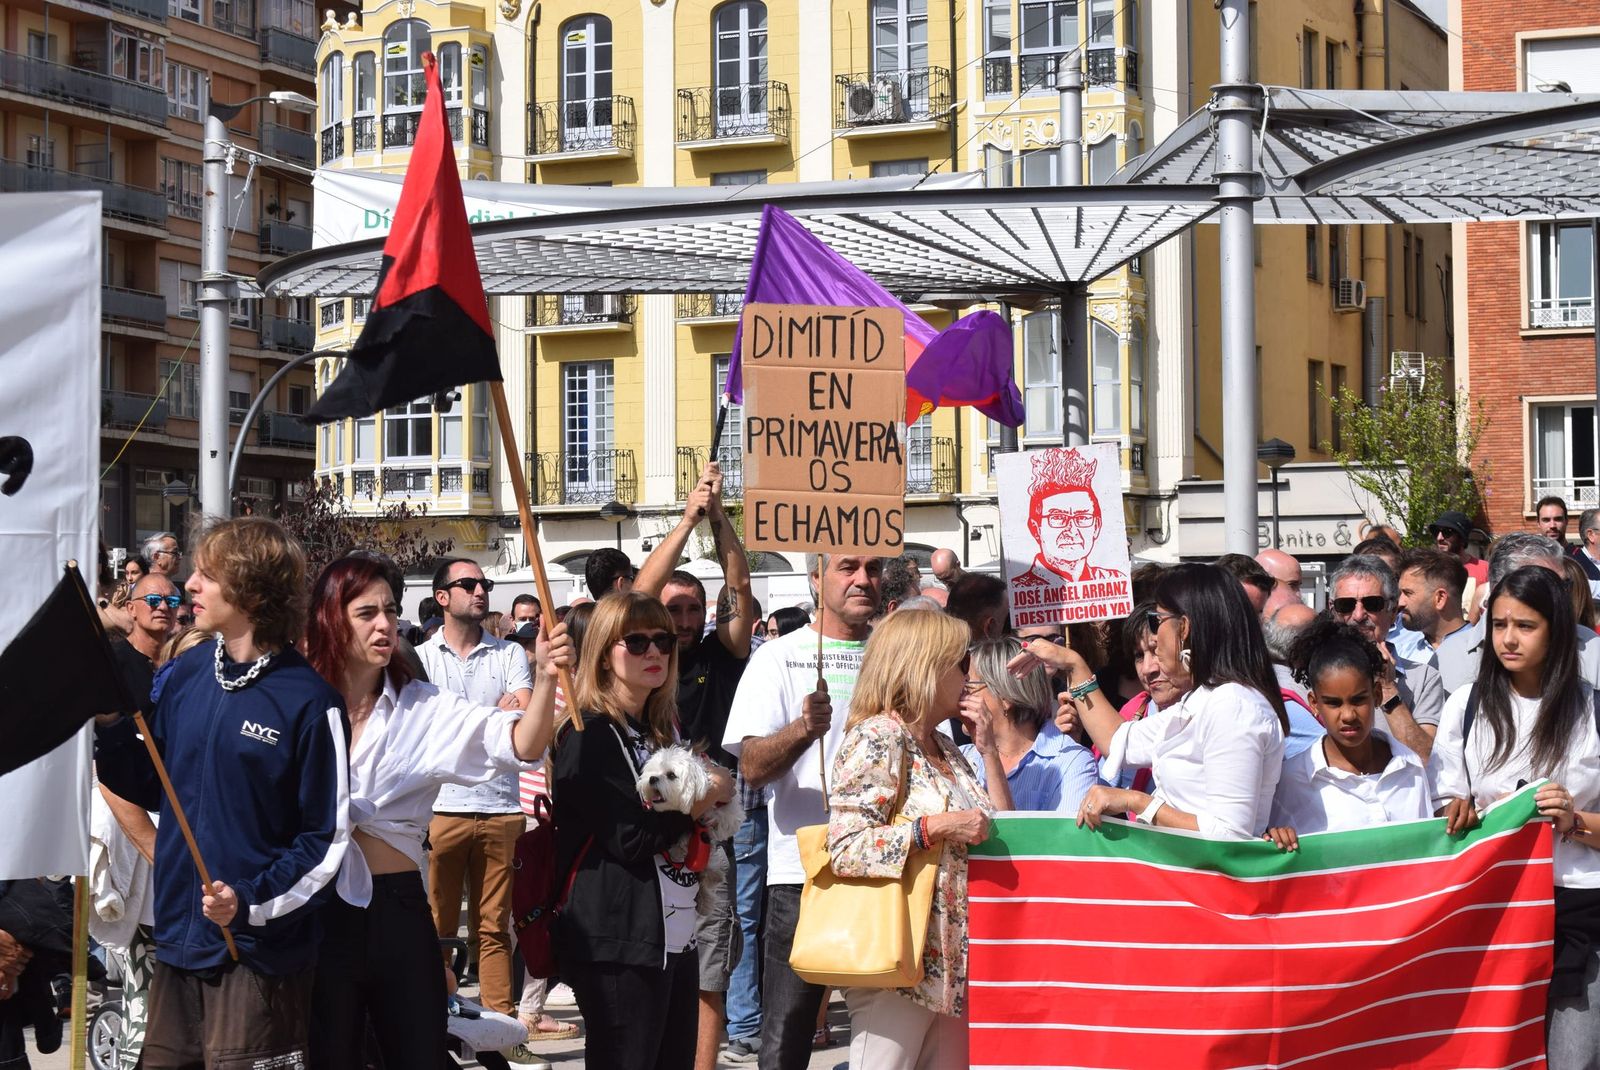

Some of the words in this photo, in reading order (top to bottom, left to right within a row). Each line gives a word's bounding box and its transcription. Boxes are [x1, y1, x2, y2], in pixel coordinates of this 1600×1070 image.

[364, 208, 389, 229] Dí
[809, 371, 853, 410] EN
[809, 459, 852, 493] OS
[755, 501, 903, 547] ECHAMOS
[1333, 520, 1352, 547] &
[1014, 586, 1041, 606] JOSÉ
[1043, 584, 1080, 603] ÁNGEL
[1082, 580, 1128, 600] ARRANZ
[1015, 603, 1107, 627] ¡DESTITUCIÓN
[1110, 602, 1131, 615] YA!
[806, 661, 830, 669] MAER
[835, 662, 860, 670] OFFICIA
[813, 653, 853, 662] RGISTERED
[242, 719, 280, 741] NYC
[659, 864, 699, 887] ZAMOR
